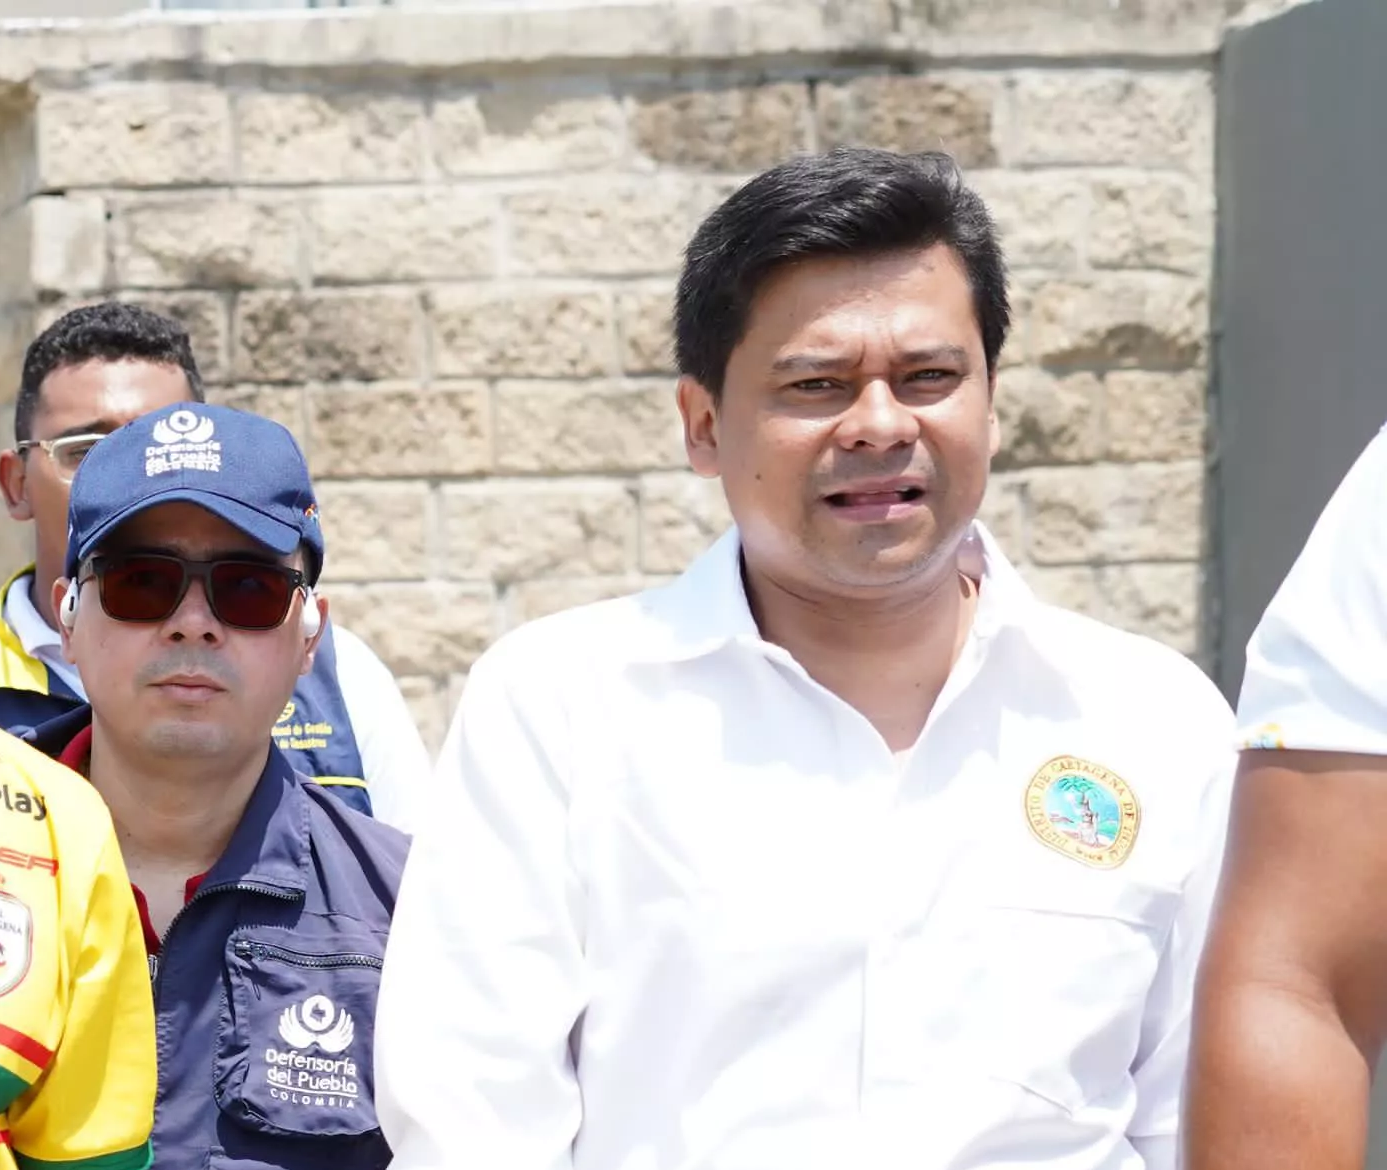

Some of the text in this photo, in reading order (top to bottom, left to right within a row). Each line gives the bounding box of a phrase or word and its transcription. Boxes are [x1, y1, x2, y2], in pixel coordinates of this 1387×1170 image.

[265, 1049, 356, 1077] Defensoría
[267, 1066, 357, 1094] del Pueblo
[270, 1088, 355, 1109] COLOMBIA
